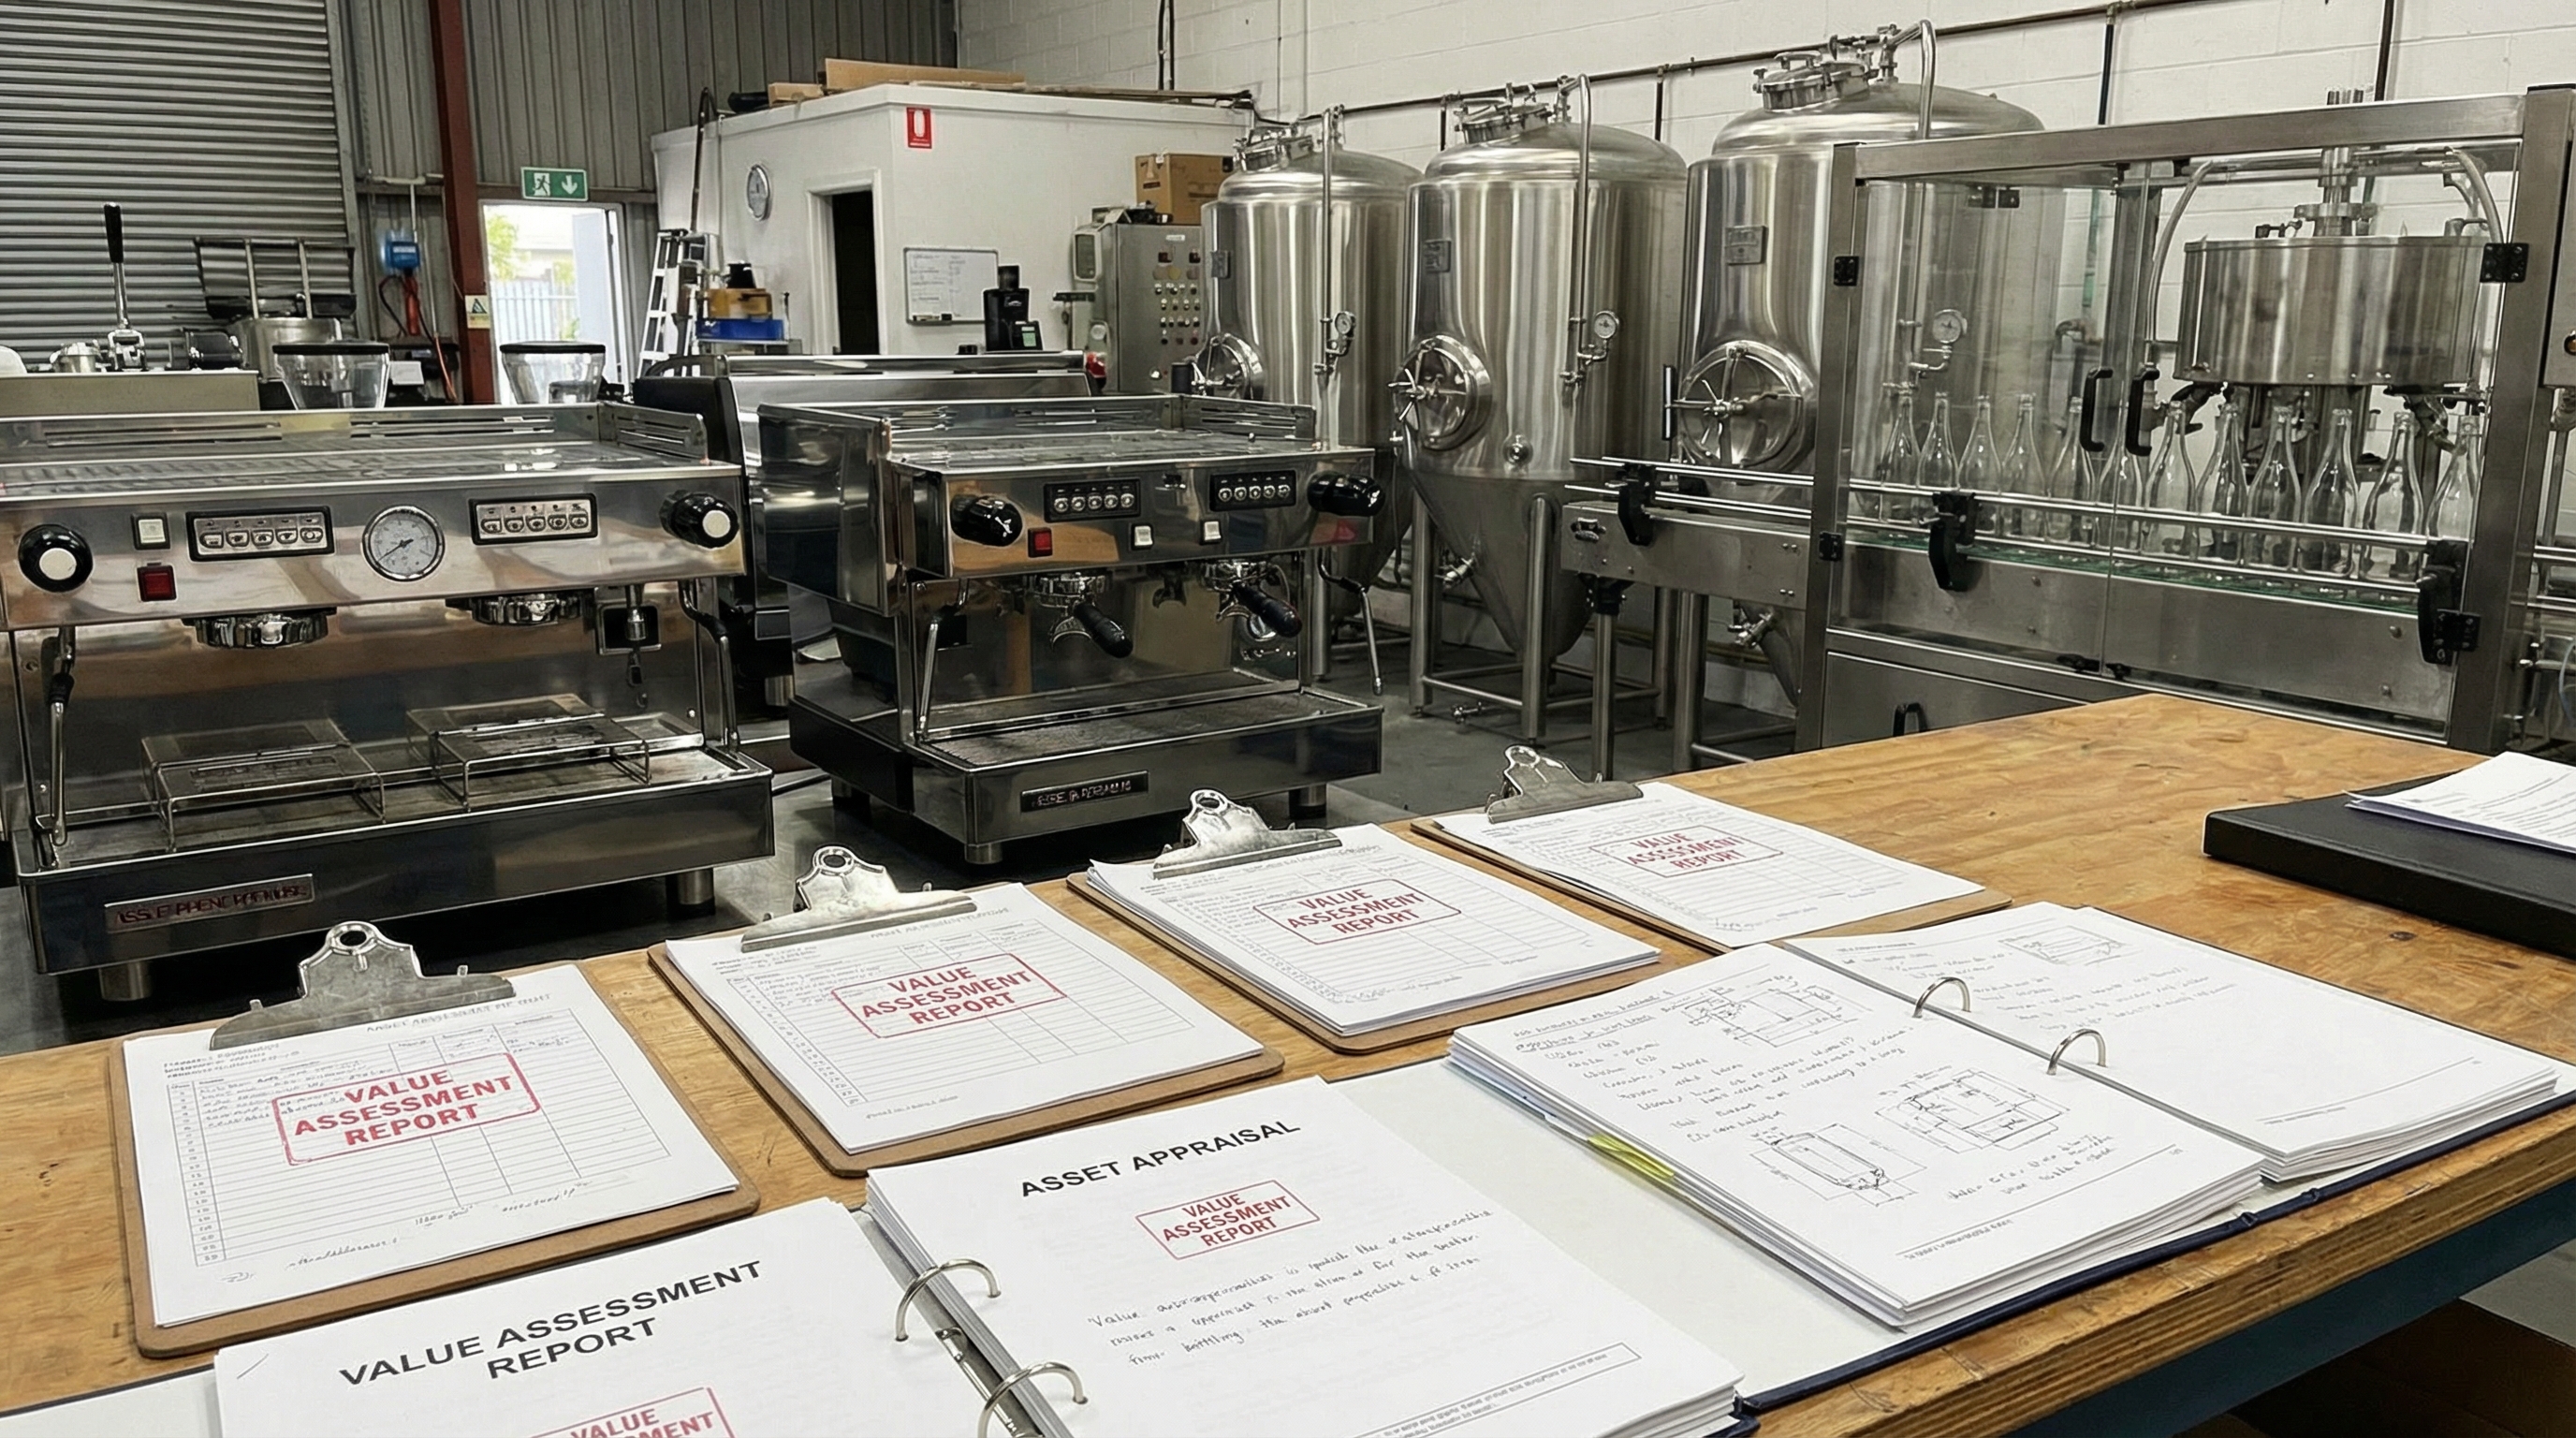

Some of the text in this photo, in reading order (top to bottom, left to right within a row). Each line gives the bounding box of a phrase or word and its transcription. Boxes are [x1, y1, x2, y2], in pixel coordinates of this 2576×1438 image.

[1287, 892, 1425, 928] ASSESSMENT
[1297, 888, 1373, 910] VALUE
[1331, 909, 1420, 934] REPORT
[861, 970, 1032, 1019] ASSESSMENT
[887, 966, 978, 994] VALUE
[909, 991, 1016, 1026] REPORT
[344, 1070, 454, 1104] VALUE
[294, 1076, 512, 1136] ASSESSMENT
[344, 1104, 478, 1146] REPORT
[1021, 1121, 1302, 1197] ASSET APPRAISAL
[1162, 1196, 1292, 1241] ASSESSMENT
[1182, 1193, 1246, 1218] VALUE
[1200, 1217, 1278, 1247] REPORT
[339, 1259, 763, 1386] VALUE ASSESSMENT
[487, 1316, 657, 1380] REPORT
